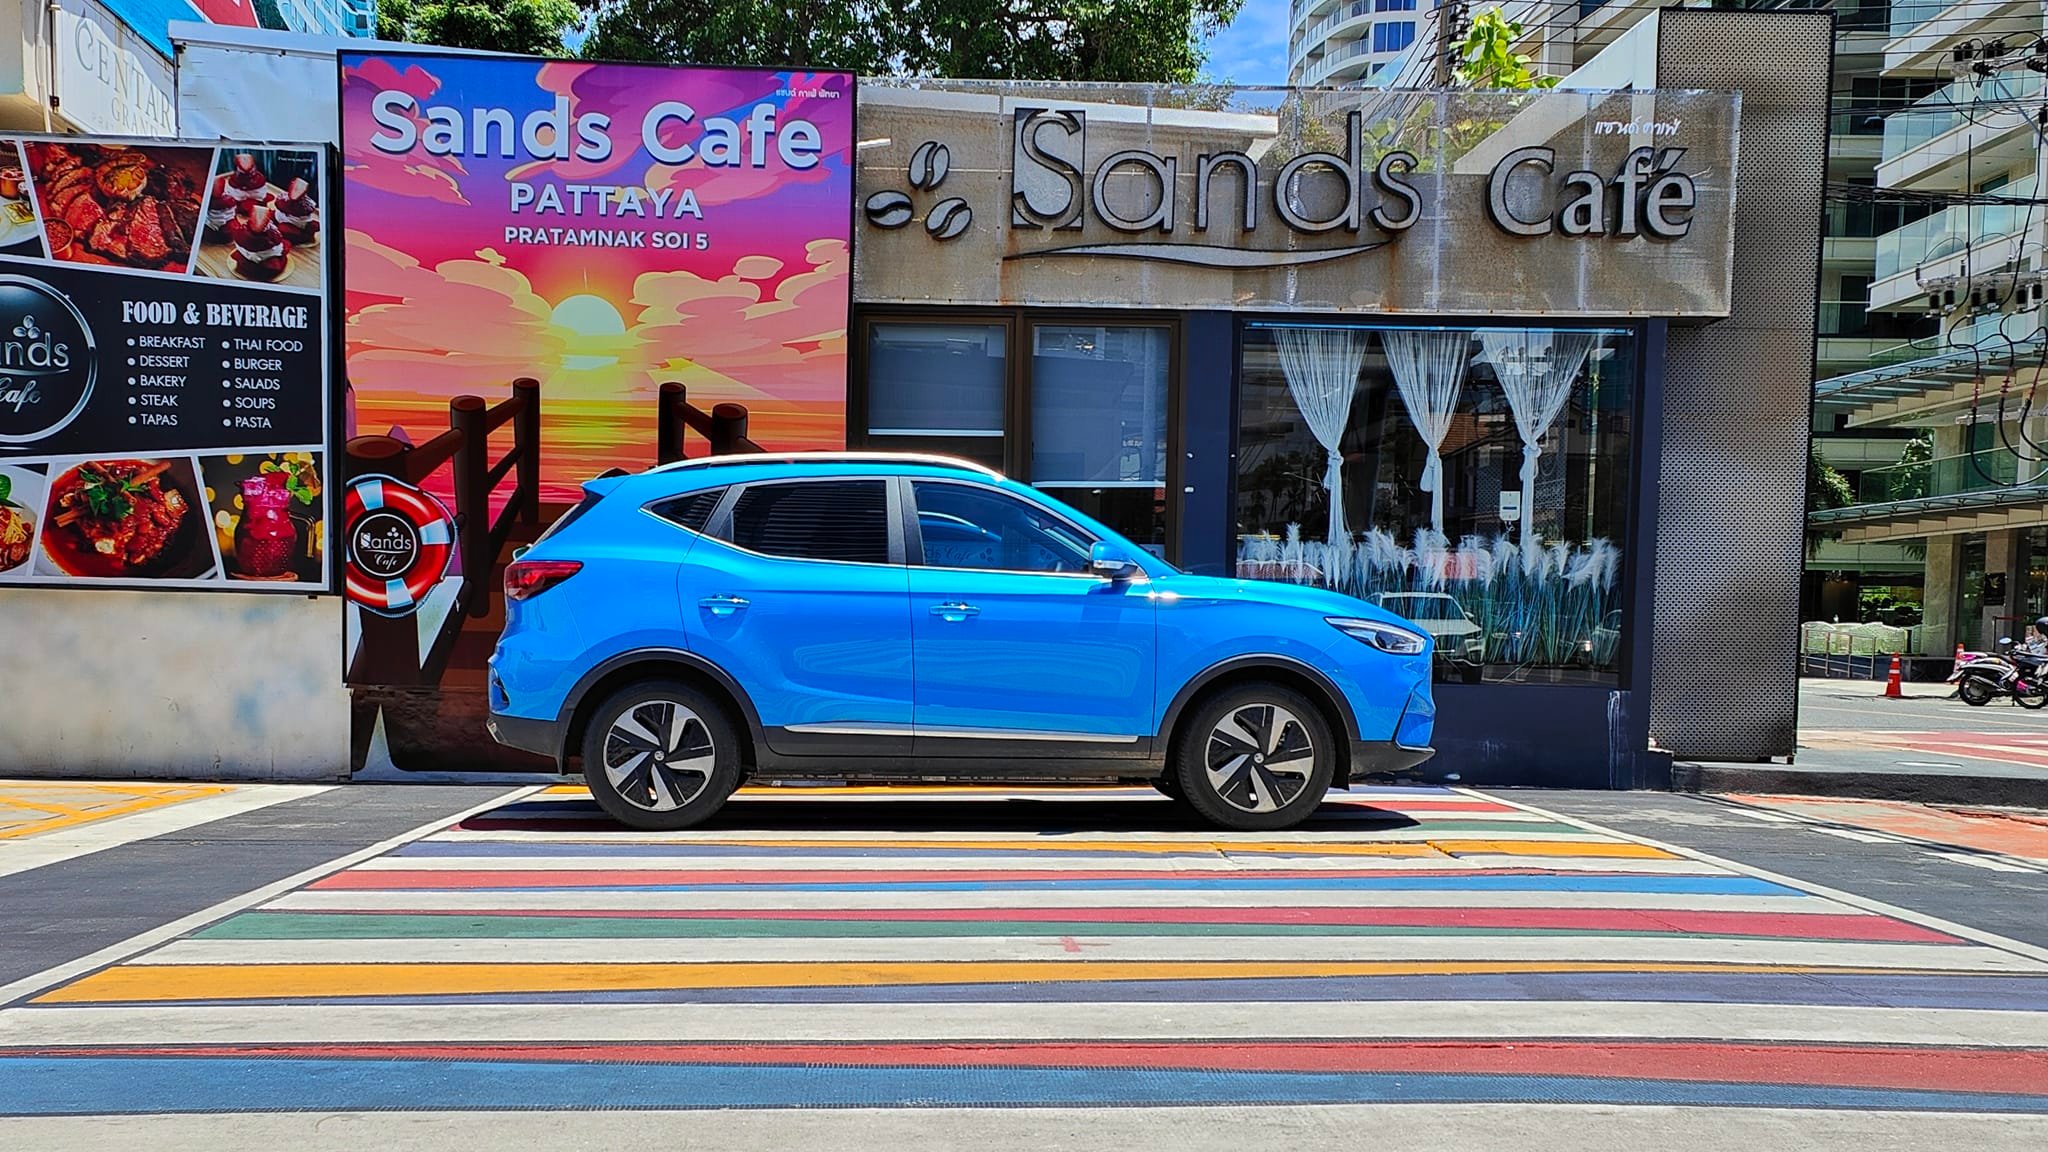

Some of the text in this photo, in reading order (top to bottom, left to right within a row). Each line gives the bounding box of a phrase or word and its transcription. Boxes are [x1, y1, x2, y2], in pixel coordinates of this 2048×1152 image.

[370, 90, 823, 170] Sands Cafe
[1012, 107, 1696, 241] Sands Café
[510, 183, 704, 219] PATTAYA
[504, 226, 709, 250] PRATAMNAK SOI 5
[122, 301, 308, 329] FOOD & BEVERAGE
[139, 336, 206, 349] BREAKFAST
[234, 338, 303, 352] THAI FOOD
[0, 332, 69, 367] nds
[139, 355, 190, 368] DESSERT
[234, 358, 283, 371] BURGER
[140, 374, 187, 387] BAKERY
[234, 377, 281, 390] SALADS
[140, 394, 178, 407] STEAK
[234, 396, 276, 409] SOUPS
[140, 413, 178, 426] TAPAS
[235, 415, 272, 428] PASTA
[360, 532, 412, 550] Sands
[374, 552, 398, 570] Cafe
